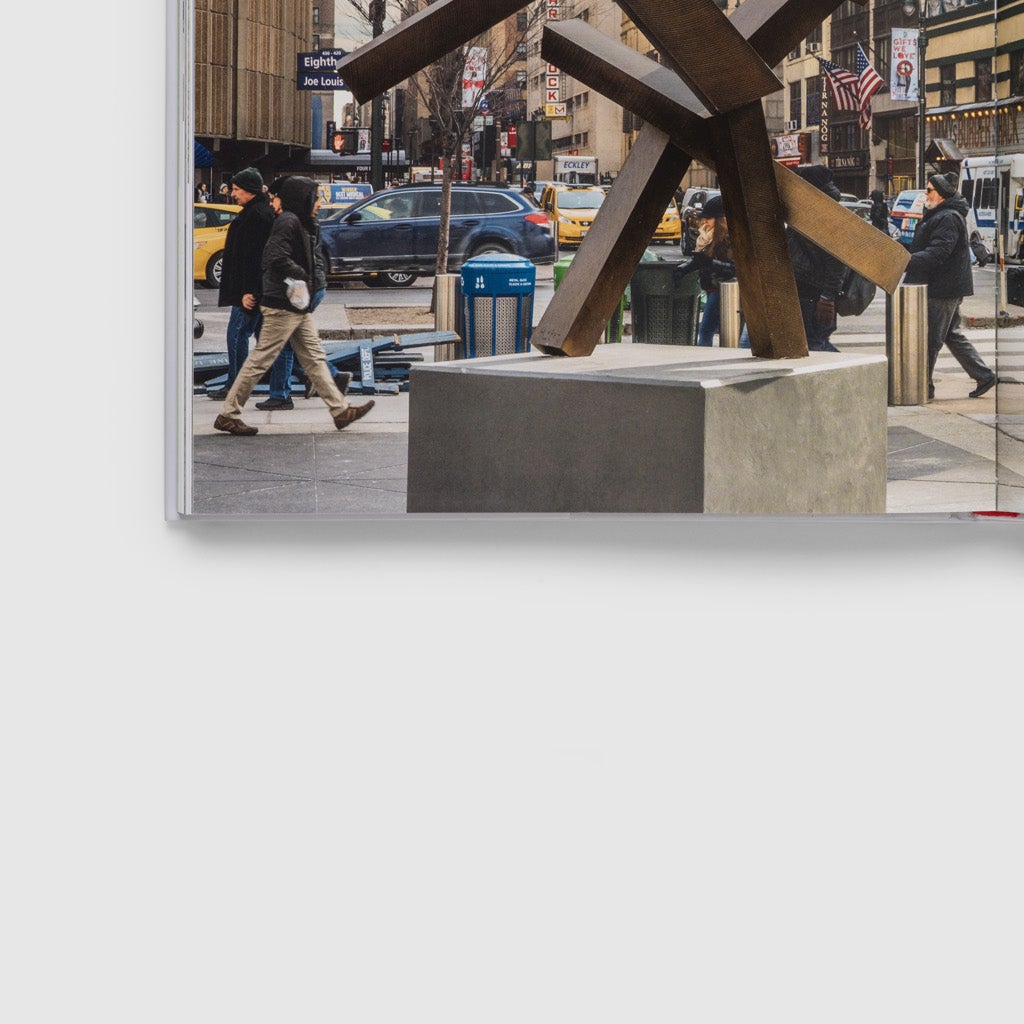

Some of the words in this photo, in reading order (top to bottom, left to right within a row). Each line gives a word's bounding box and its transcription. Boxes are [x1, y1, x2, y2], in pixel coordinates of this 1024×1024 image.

[304, 57, 337, 69] Eighth
[303, 76, 319, 86] Joe
[321, 76, 344, 86] Louis
[563, 161, 590, 169] ECKLEY
